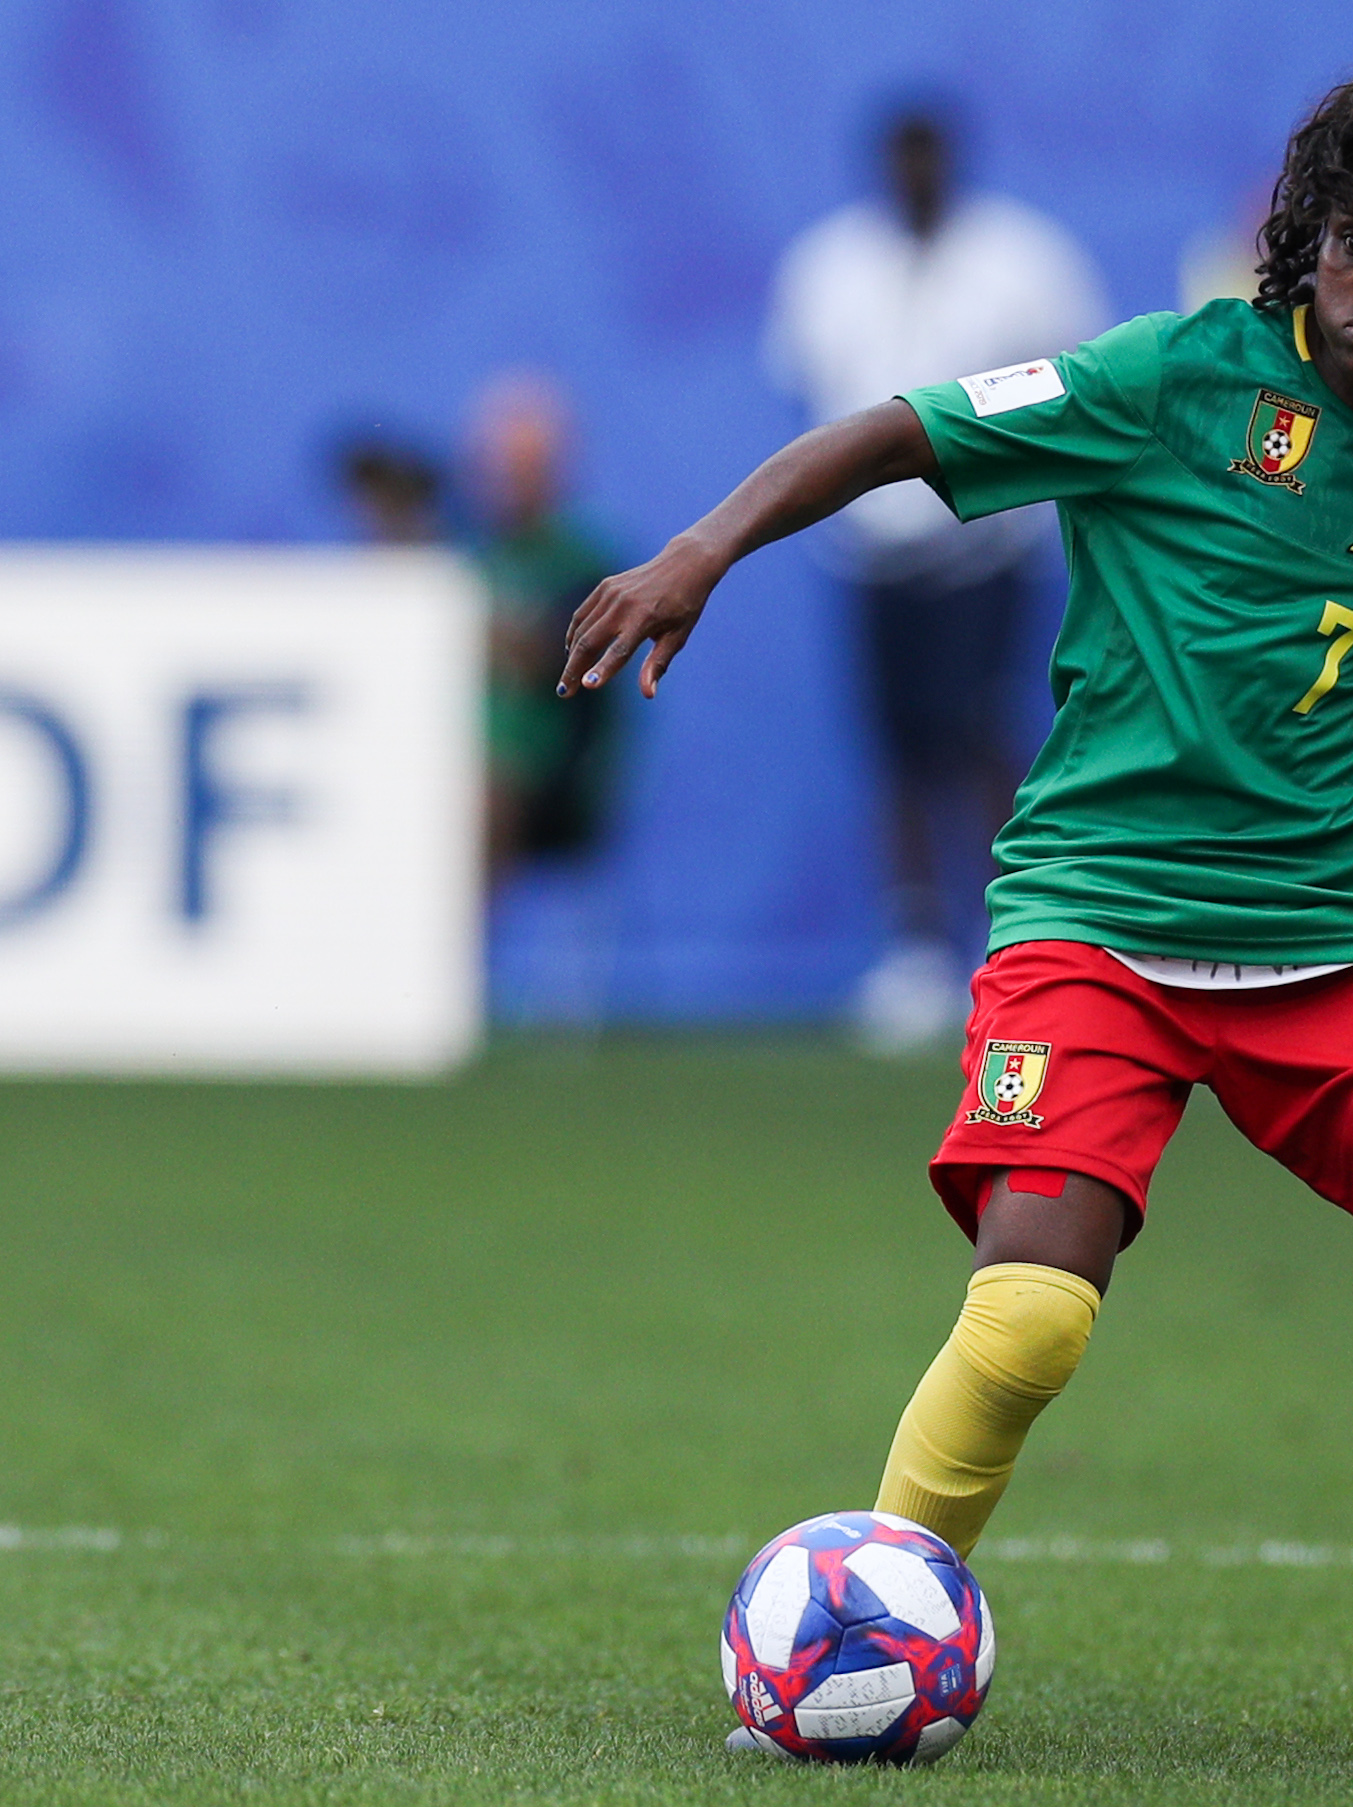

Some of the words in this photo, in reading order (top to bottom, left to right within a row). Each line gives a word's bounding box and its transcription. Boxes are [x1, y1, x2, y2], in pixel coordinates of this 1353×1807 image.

[1264, 392, 1316, 416] CAMEROUN
[991, 1043, 1044, 1053] CAMEROUN
[750, 1671, 765, 1727] adidas
